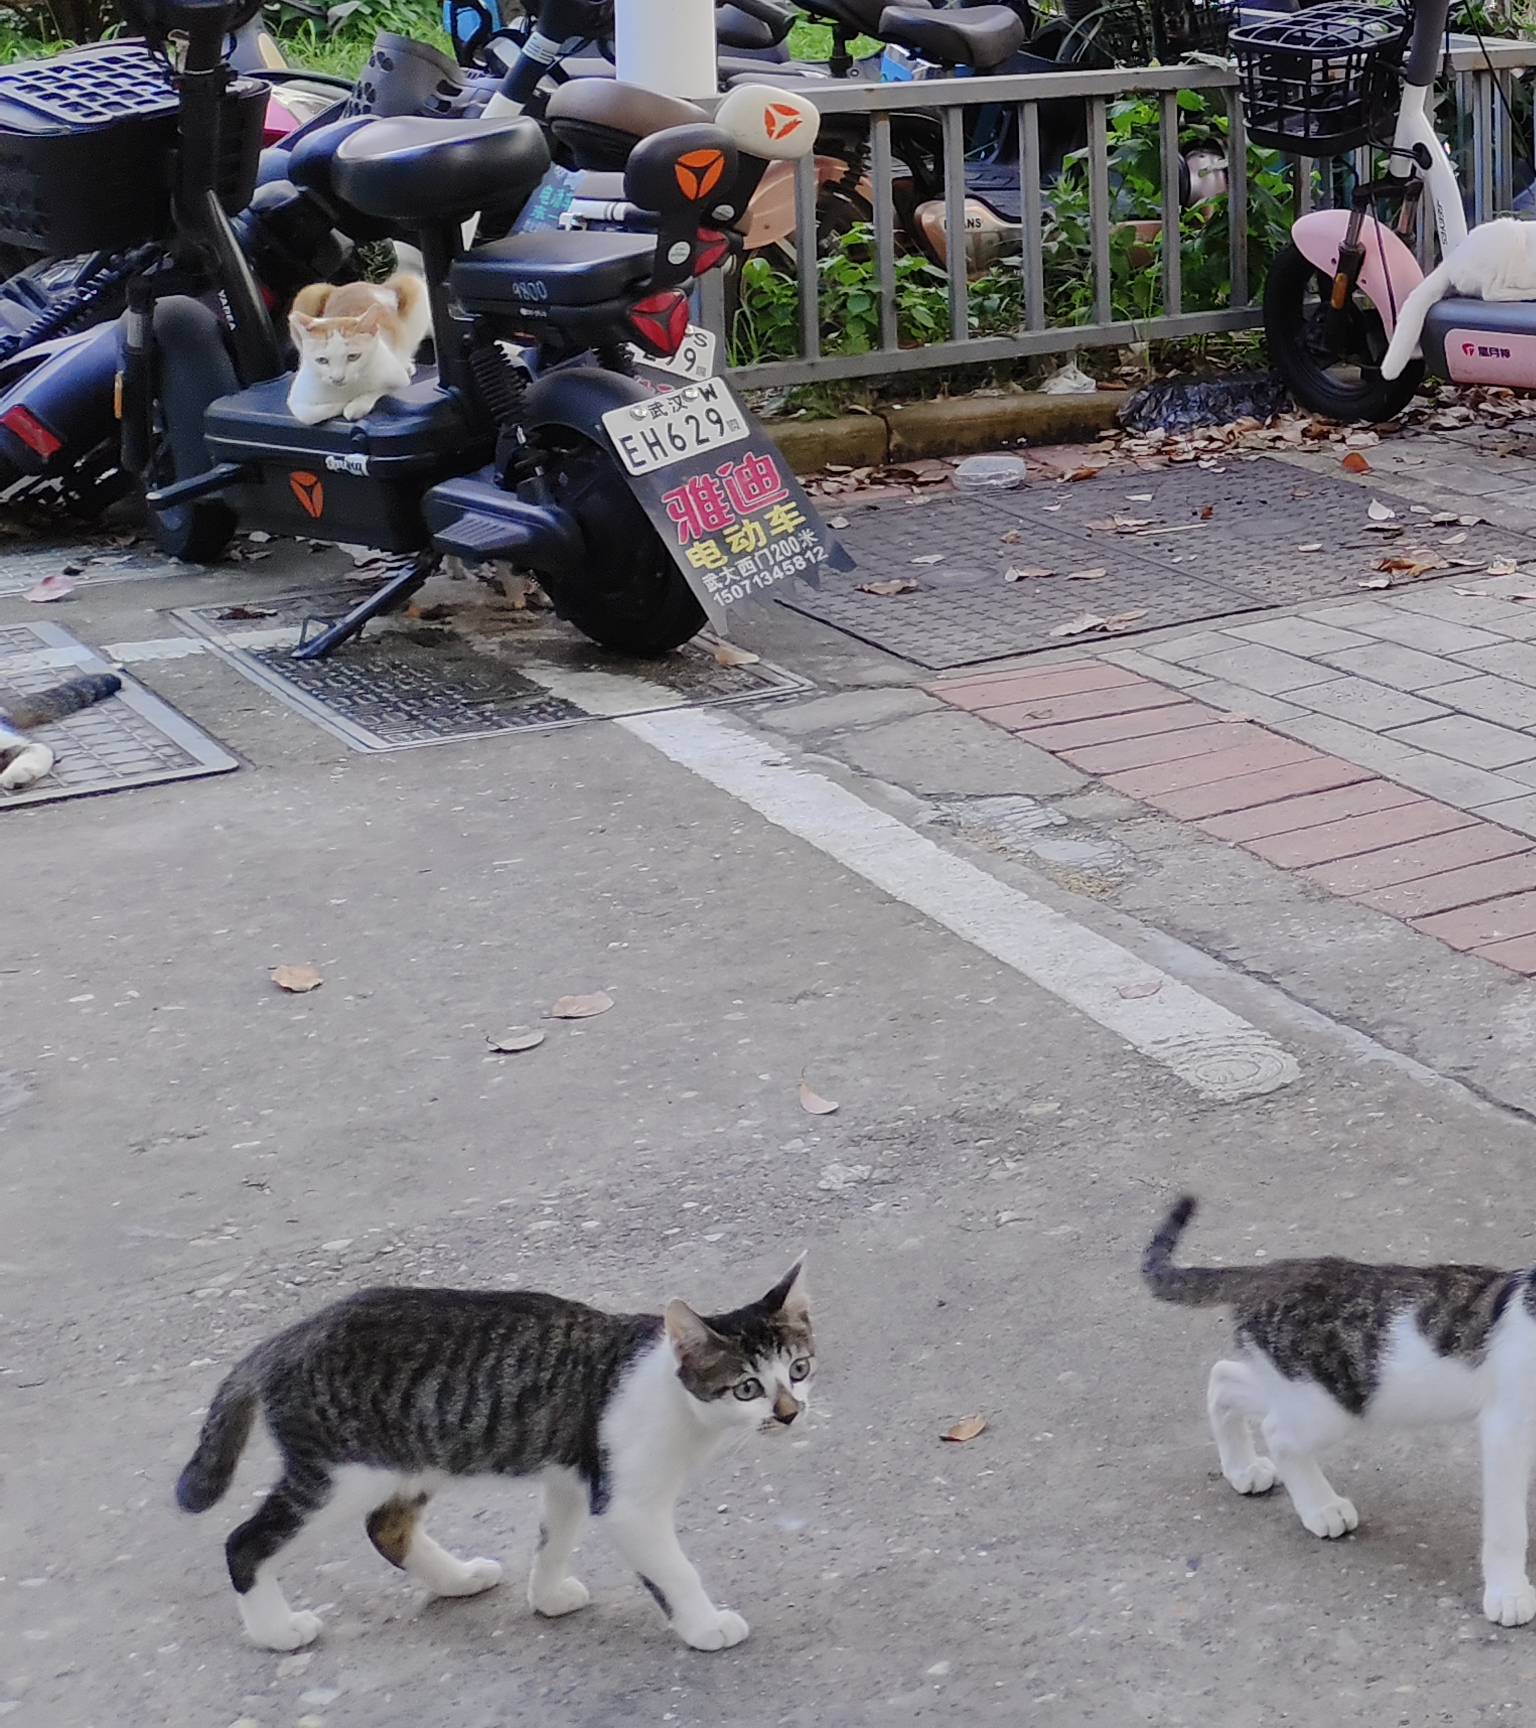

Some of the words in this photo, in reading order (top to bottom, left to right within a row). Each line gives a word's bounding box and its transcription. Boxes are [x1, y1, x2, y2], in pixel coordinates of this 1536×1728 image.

[648, 395, 690, 421] 武汉
[699, 383, 719, 403] W
[618, 407, 726, 469] EH629
[662, 451, 789, 545] 雅迪
[685, 501, 806, 570] 电动车
[702, 528, 819, 593] 武大西门200米
[713, 545, 829, 607] 15071345812
